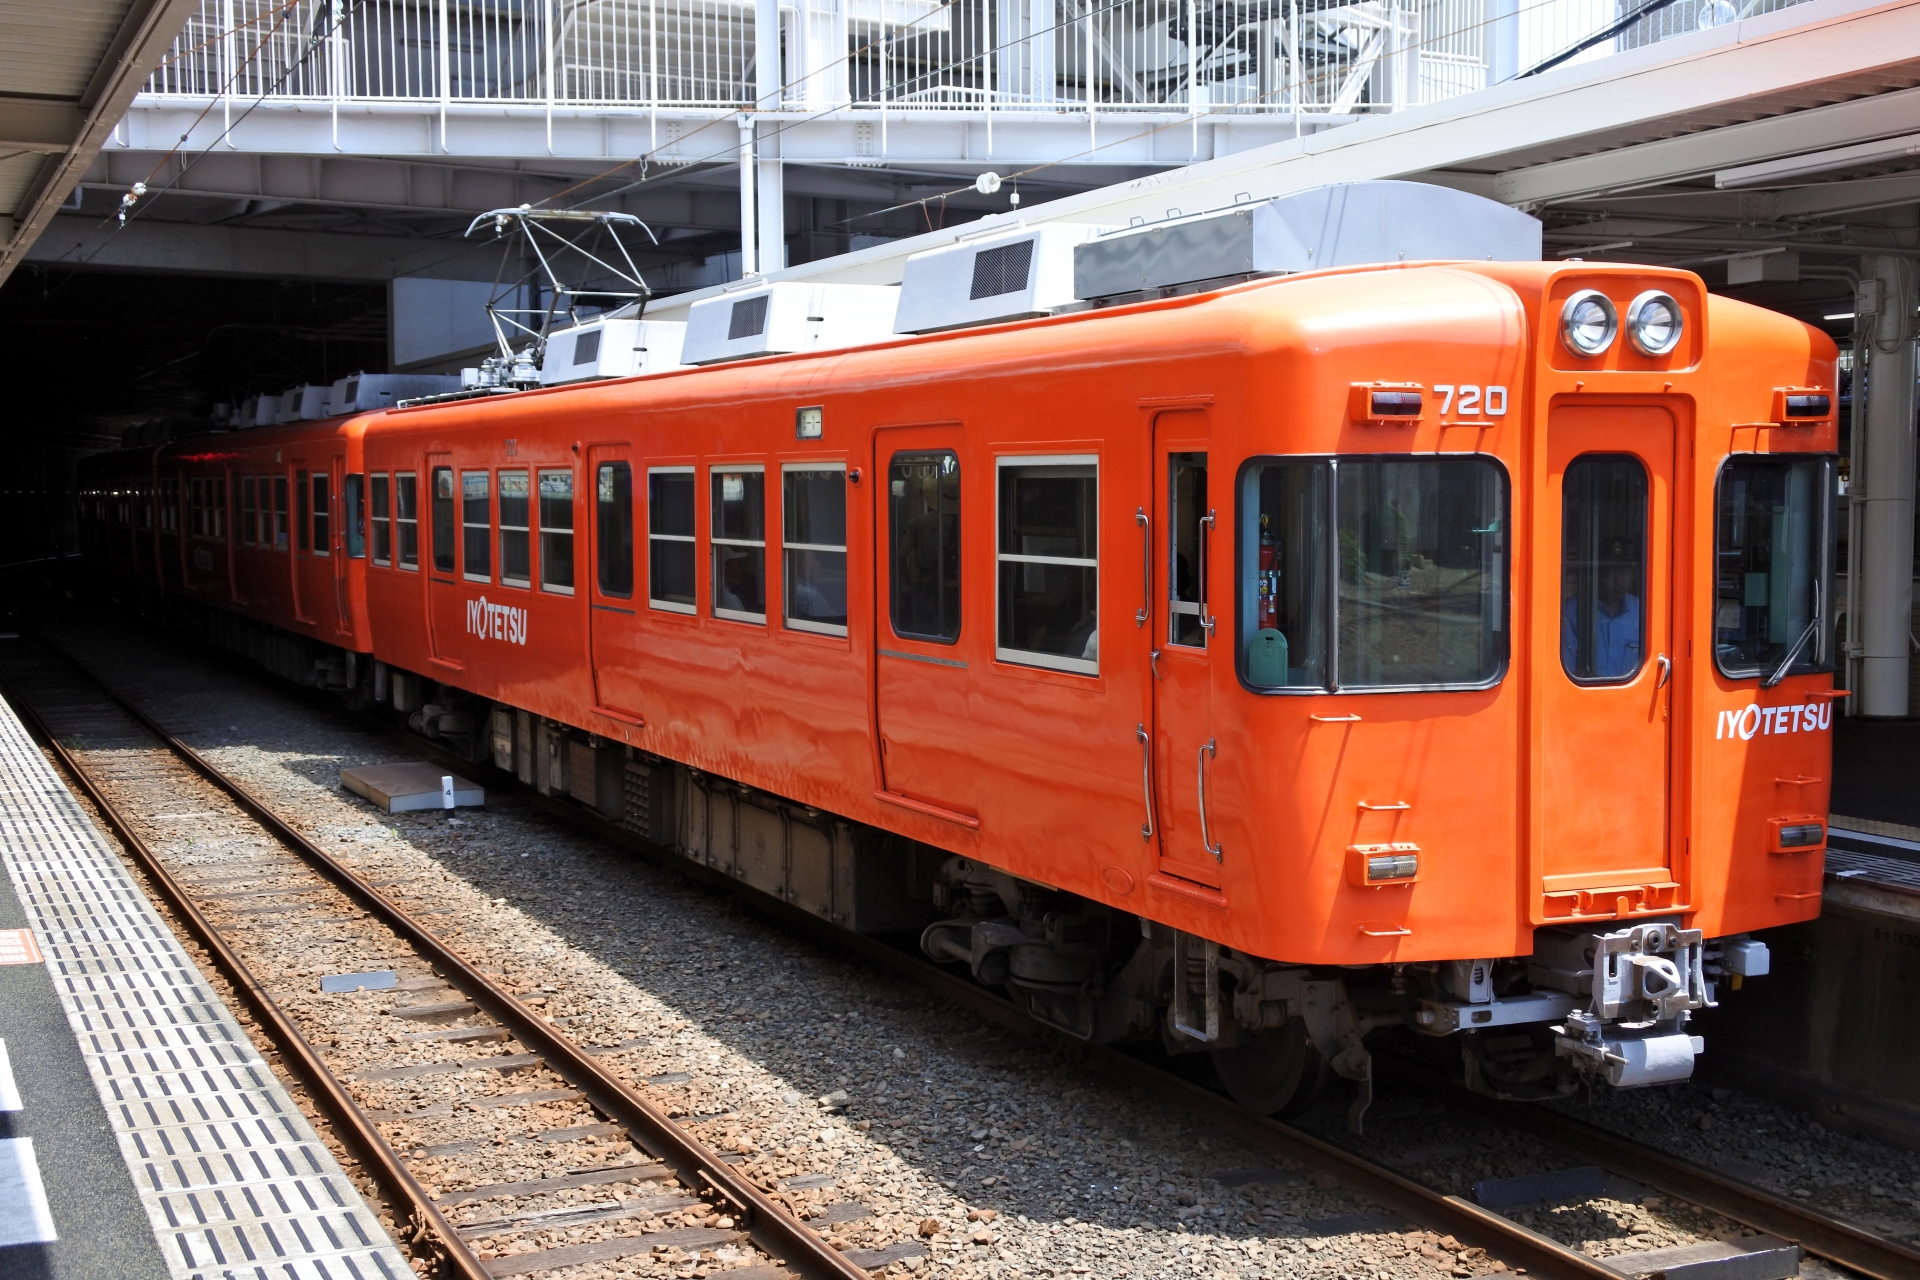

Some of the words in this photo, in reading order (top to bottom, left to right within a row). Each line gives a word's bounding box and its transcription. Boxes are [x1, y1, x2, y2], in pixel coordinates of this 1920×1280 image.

[1433, 384, 1508, 416] 720
[467, 595, 527, 646] IYOTETSU
[1716, 702, 1832, 741] IYOTETSU
